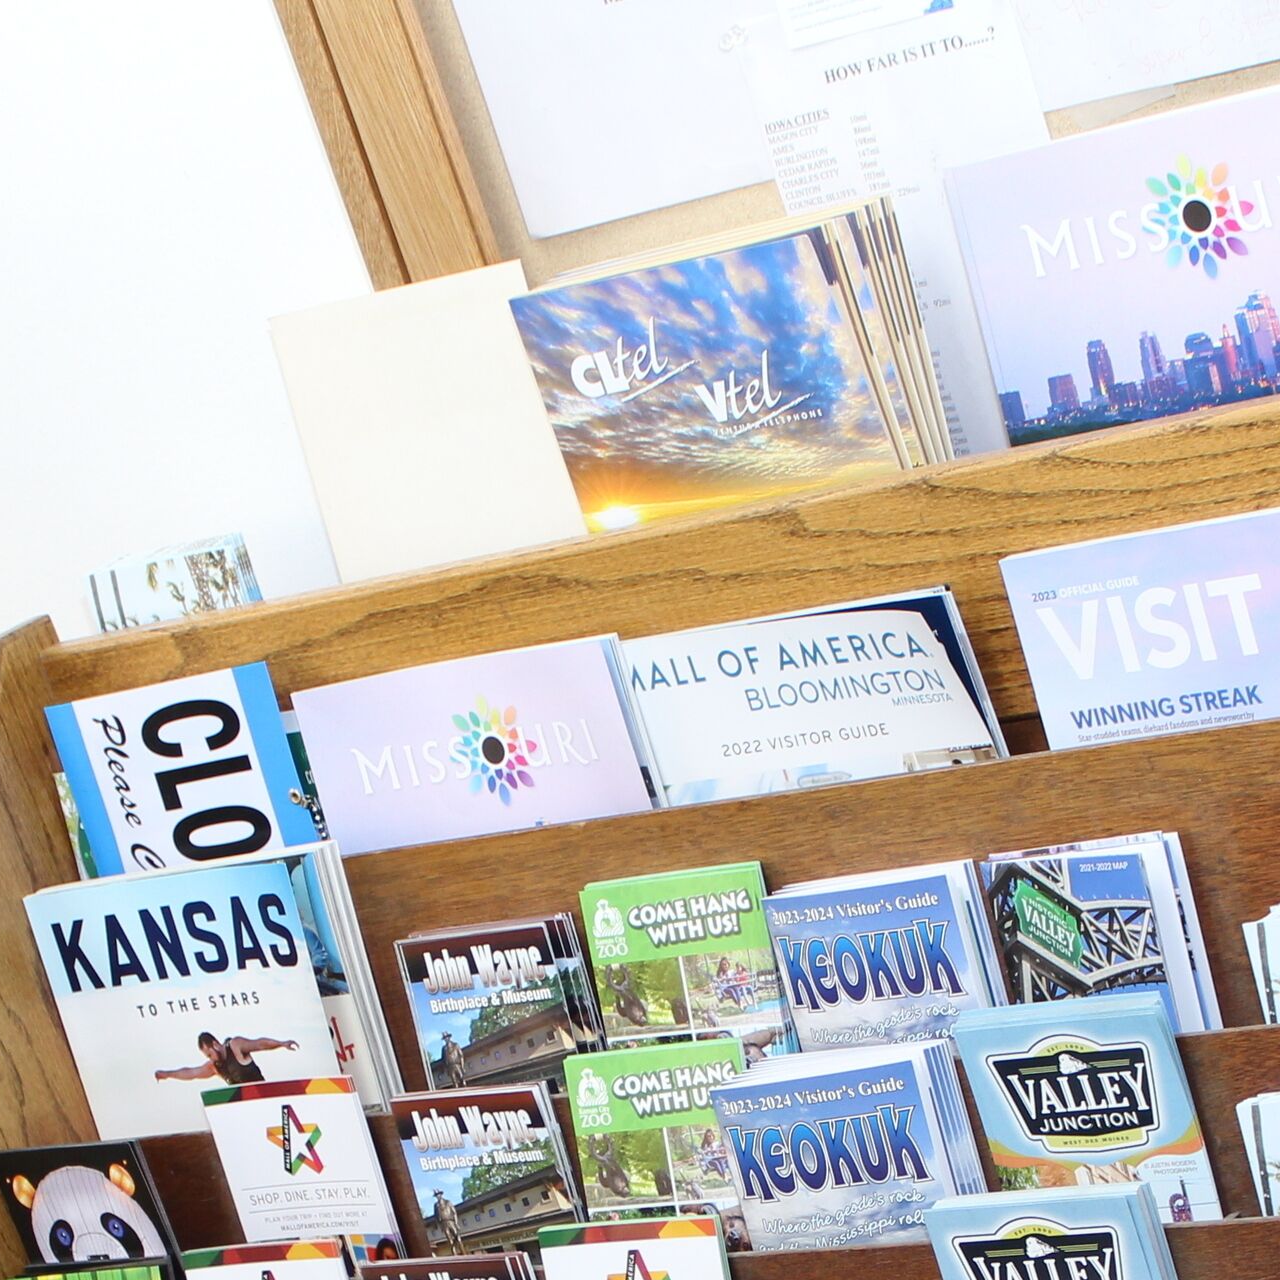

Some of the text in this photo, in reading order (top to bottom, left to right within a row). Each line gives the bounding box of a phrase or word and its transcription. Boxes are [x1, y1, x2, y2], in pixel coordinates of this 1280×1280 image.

[825, 61, 862, 84] HOW
[867, 52, 898, 73] FAR
[903, 47, 918, 64] IS
[922, 42, 937, 59] IT
[765, 108, 830, 134] IOWA CITIES
[775, 147, 829, 167] BURLINGTON
[693, 349, 783, 422] Vtel
[1032, 576, 1140, 602] 2023 OFFICIAL GUIDE
[1036, 573, 1262, 680] VISIT
[718, 646, 758, 677] OF
[744, 668, 946, 712] BLOOMINGTON
[892, 693, 952, 708] MINNESOTA
[1070, 685, 1262, 729] WINNING STREAK
[721, 722, 889, 758] 2022 VISITOR GUIDE
[51, 893, 298, 993] KANSAS
[423, 943, 546, 994] John Wayne
[775, 918, 967, 1012] KEOKUK
[137, 991, 261, 1019] TO THE STARS
[1007, 1062, 1150, 1120] VALLEY
[1039, 1111, 1140, 1133] JUNCTION
[724, 1103, 934, 1203] KEOKUK
